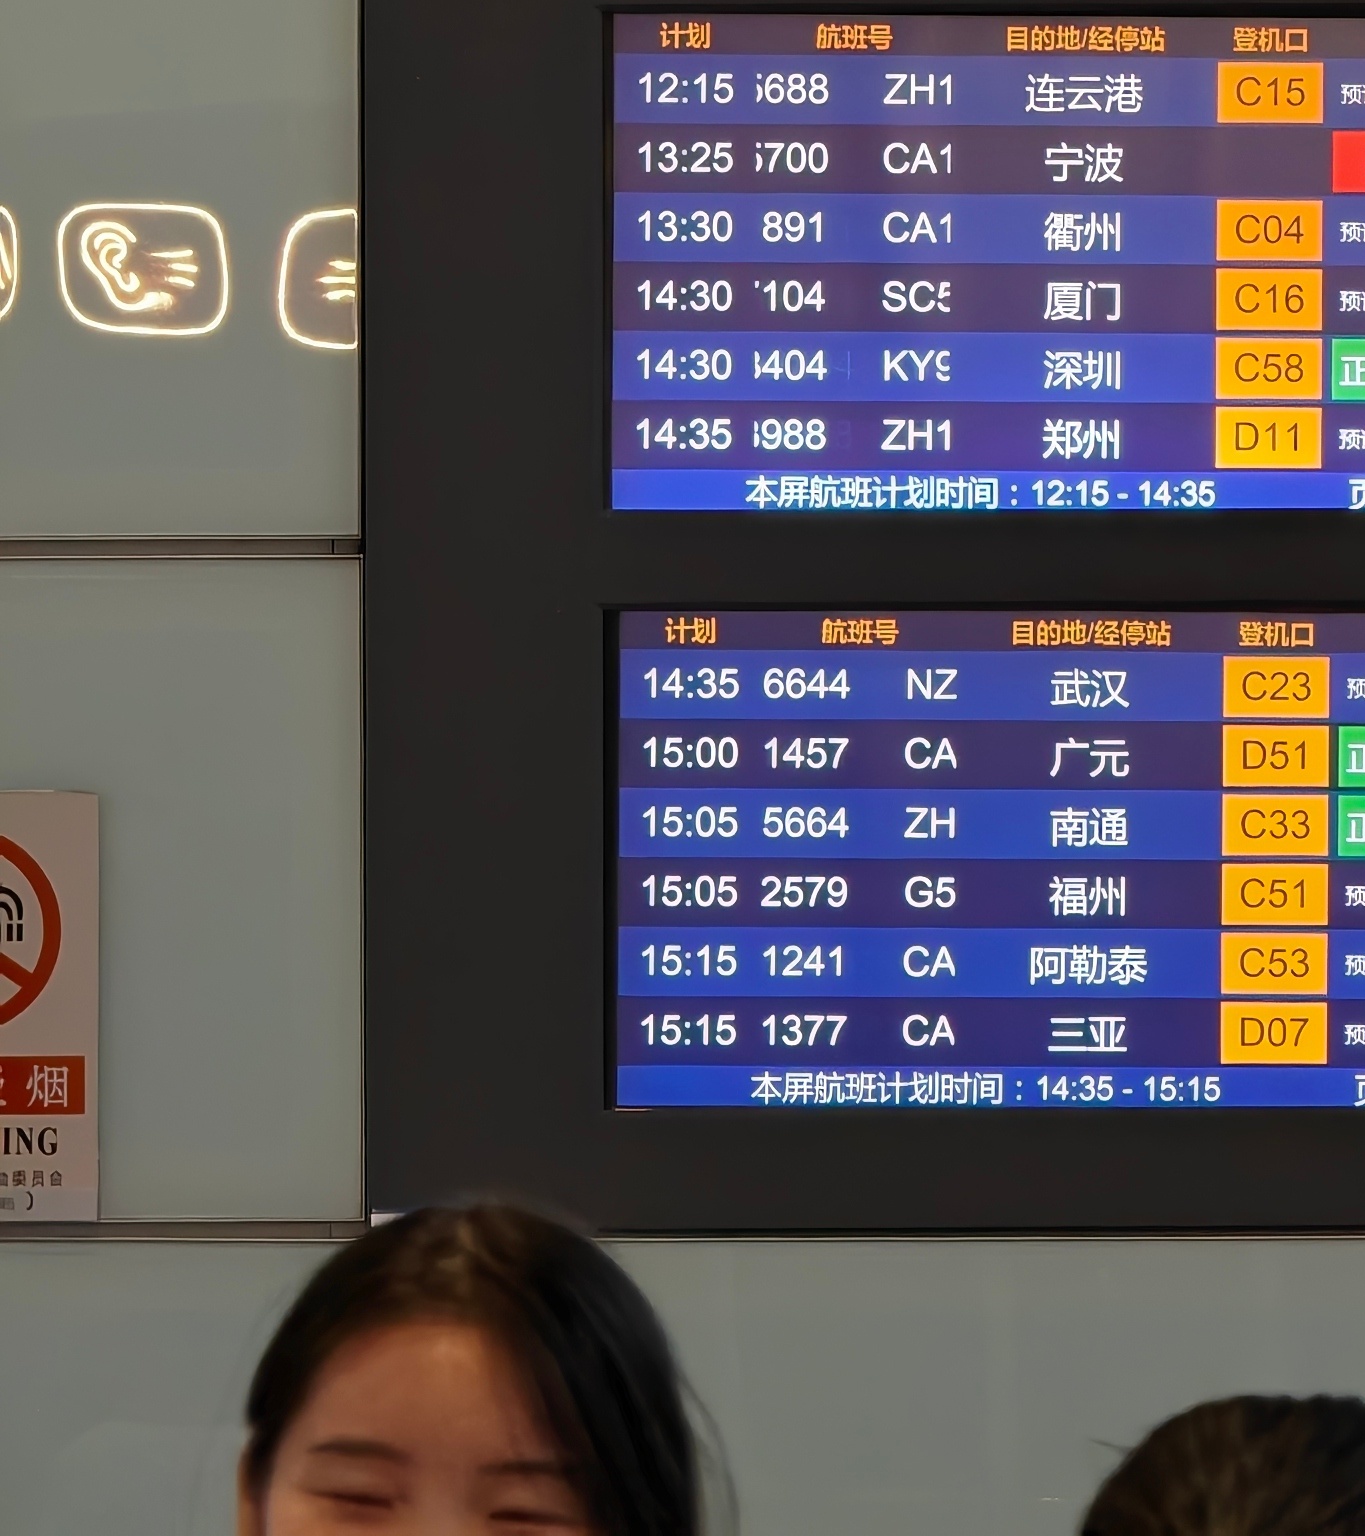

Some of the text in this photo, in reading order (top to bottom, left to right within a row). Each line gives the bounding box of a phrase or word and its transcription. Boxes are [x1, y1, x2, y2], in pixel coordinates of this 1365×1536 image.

[660, 22, 710, 48] 计划
[816, 23, 893, 50] 航班号
[1007, 25, 1165, 52] 目的地/经停站
[1233, 27, 1307, 52] 登机口
[639, 72, 733, 103] 12:15
[1025, 73, 1143, 113] 连云港
[1237, 77, 1305, 106] C15
[639, 142, 733, 173] 13:25
[1045, 142, 1123, 182] 宁波
[638, 210, 732, 242] 13:30
[1236, 215, 1304, 243] C04
[638, 280, 732, 311] 14:30
[1044, 281, 1120, 320] 厦门
[1235, 284, 1304, 313] C16
[666, 618, 716, 643] 计划
[822, 618, 898, 644] 航班号
[1013, 620, 1170, 646] 目的地/经停站
[1240, 622, 1313, 646] 登机口
[644, 668, 739, 698] 14:35
[764, 668, 850, 699] 6644
[908, 669, 957, 699] NZ
[1051, 668, 1129, 707] 武汉
[1242, 671, 1311, 701] C23
[644, 737, 738, 768] 15:00
[765, 737, 849, 768] 1457
[905, 737, 956, 769] CA
[1050, 738, 1129, 777] 广元
[1243, 741, 1305, 769] D51
[643, 806, 737, 837] 15:05
[763, 807, 849, 838] 5664
[904, 807, 955, 838] ZH
[1050, 807, 1128, 847] 南通
[1241, 809, 1310, 839] C33
[643, 875, 737, 907] 15:05
[761, 876, 847, 907] 2579
[905, 876, 955, 907] G5
[1049, 876, 1125, 916] 福州
[1241, 878, 1304, 908] C51
